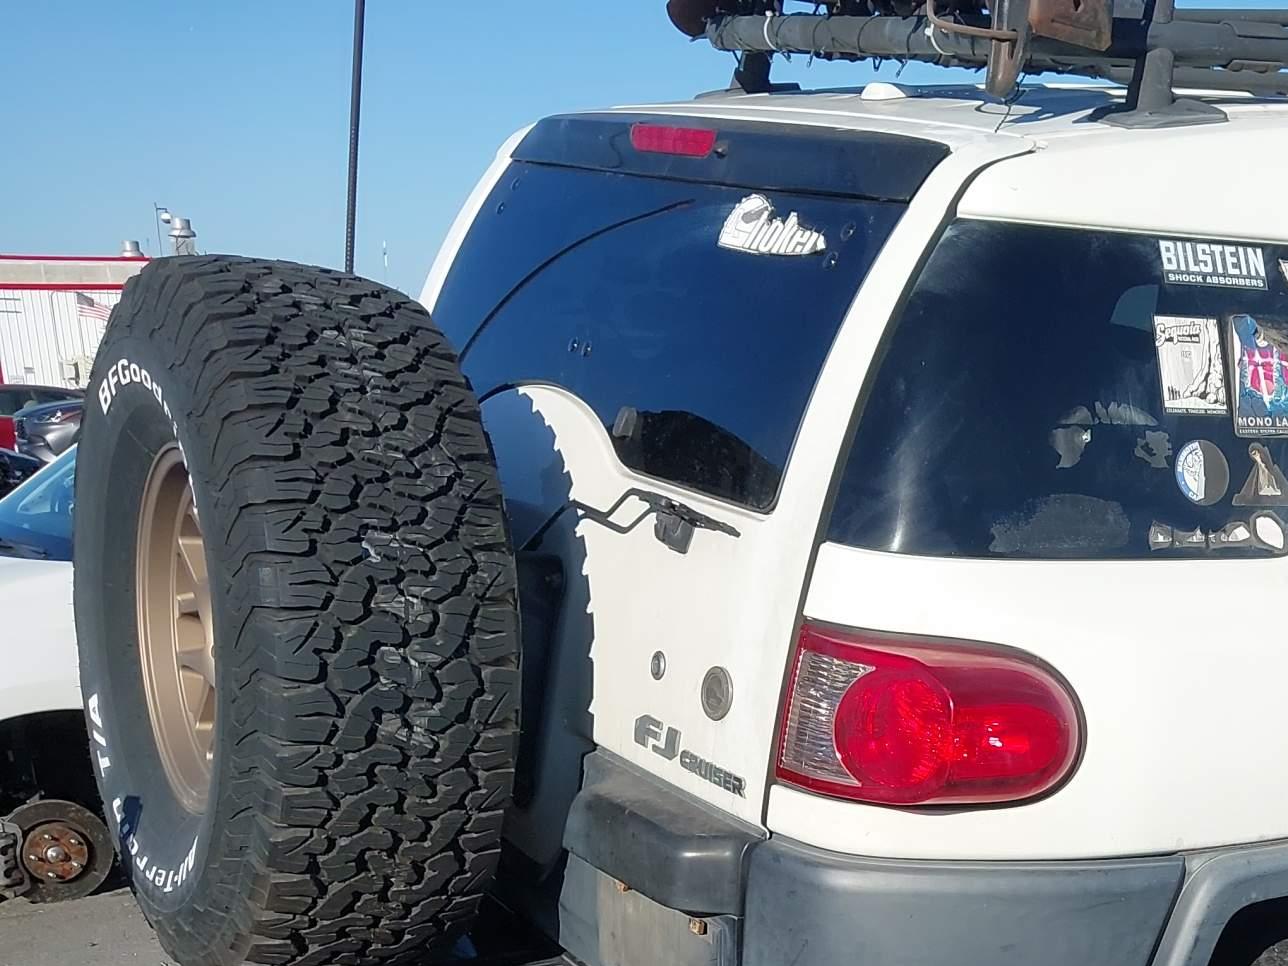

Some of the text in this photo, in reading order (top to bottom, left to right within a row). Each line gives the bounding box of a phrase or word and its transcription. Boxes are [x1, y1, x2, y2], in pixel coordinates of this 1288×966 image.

[1158, 240, 1266, 277] BILSTEIN
[1168, 273, 1264, 288] SHOCK ABSORBERS
[1155, 321, 1202, 347] Sequoia
[1238, 416, 1273, 427] MONO
[88, 693, 111, 777] T/A
[634, 714, 747, 800] FJ CRUISER
